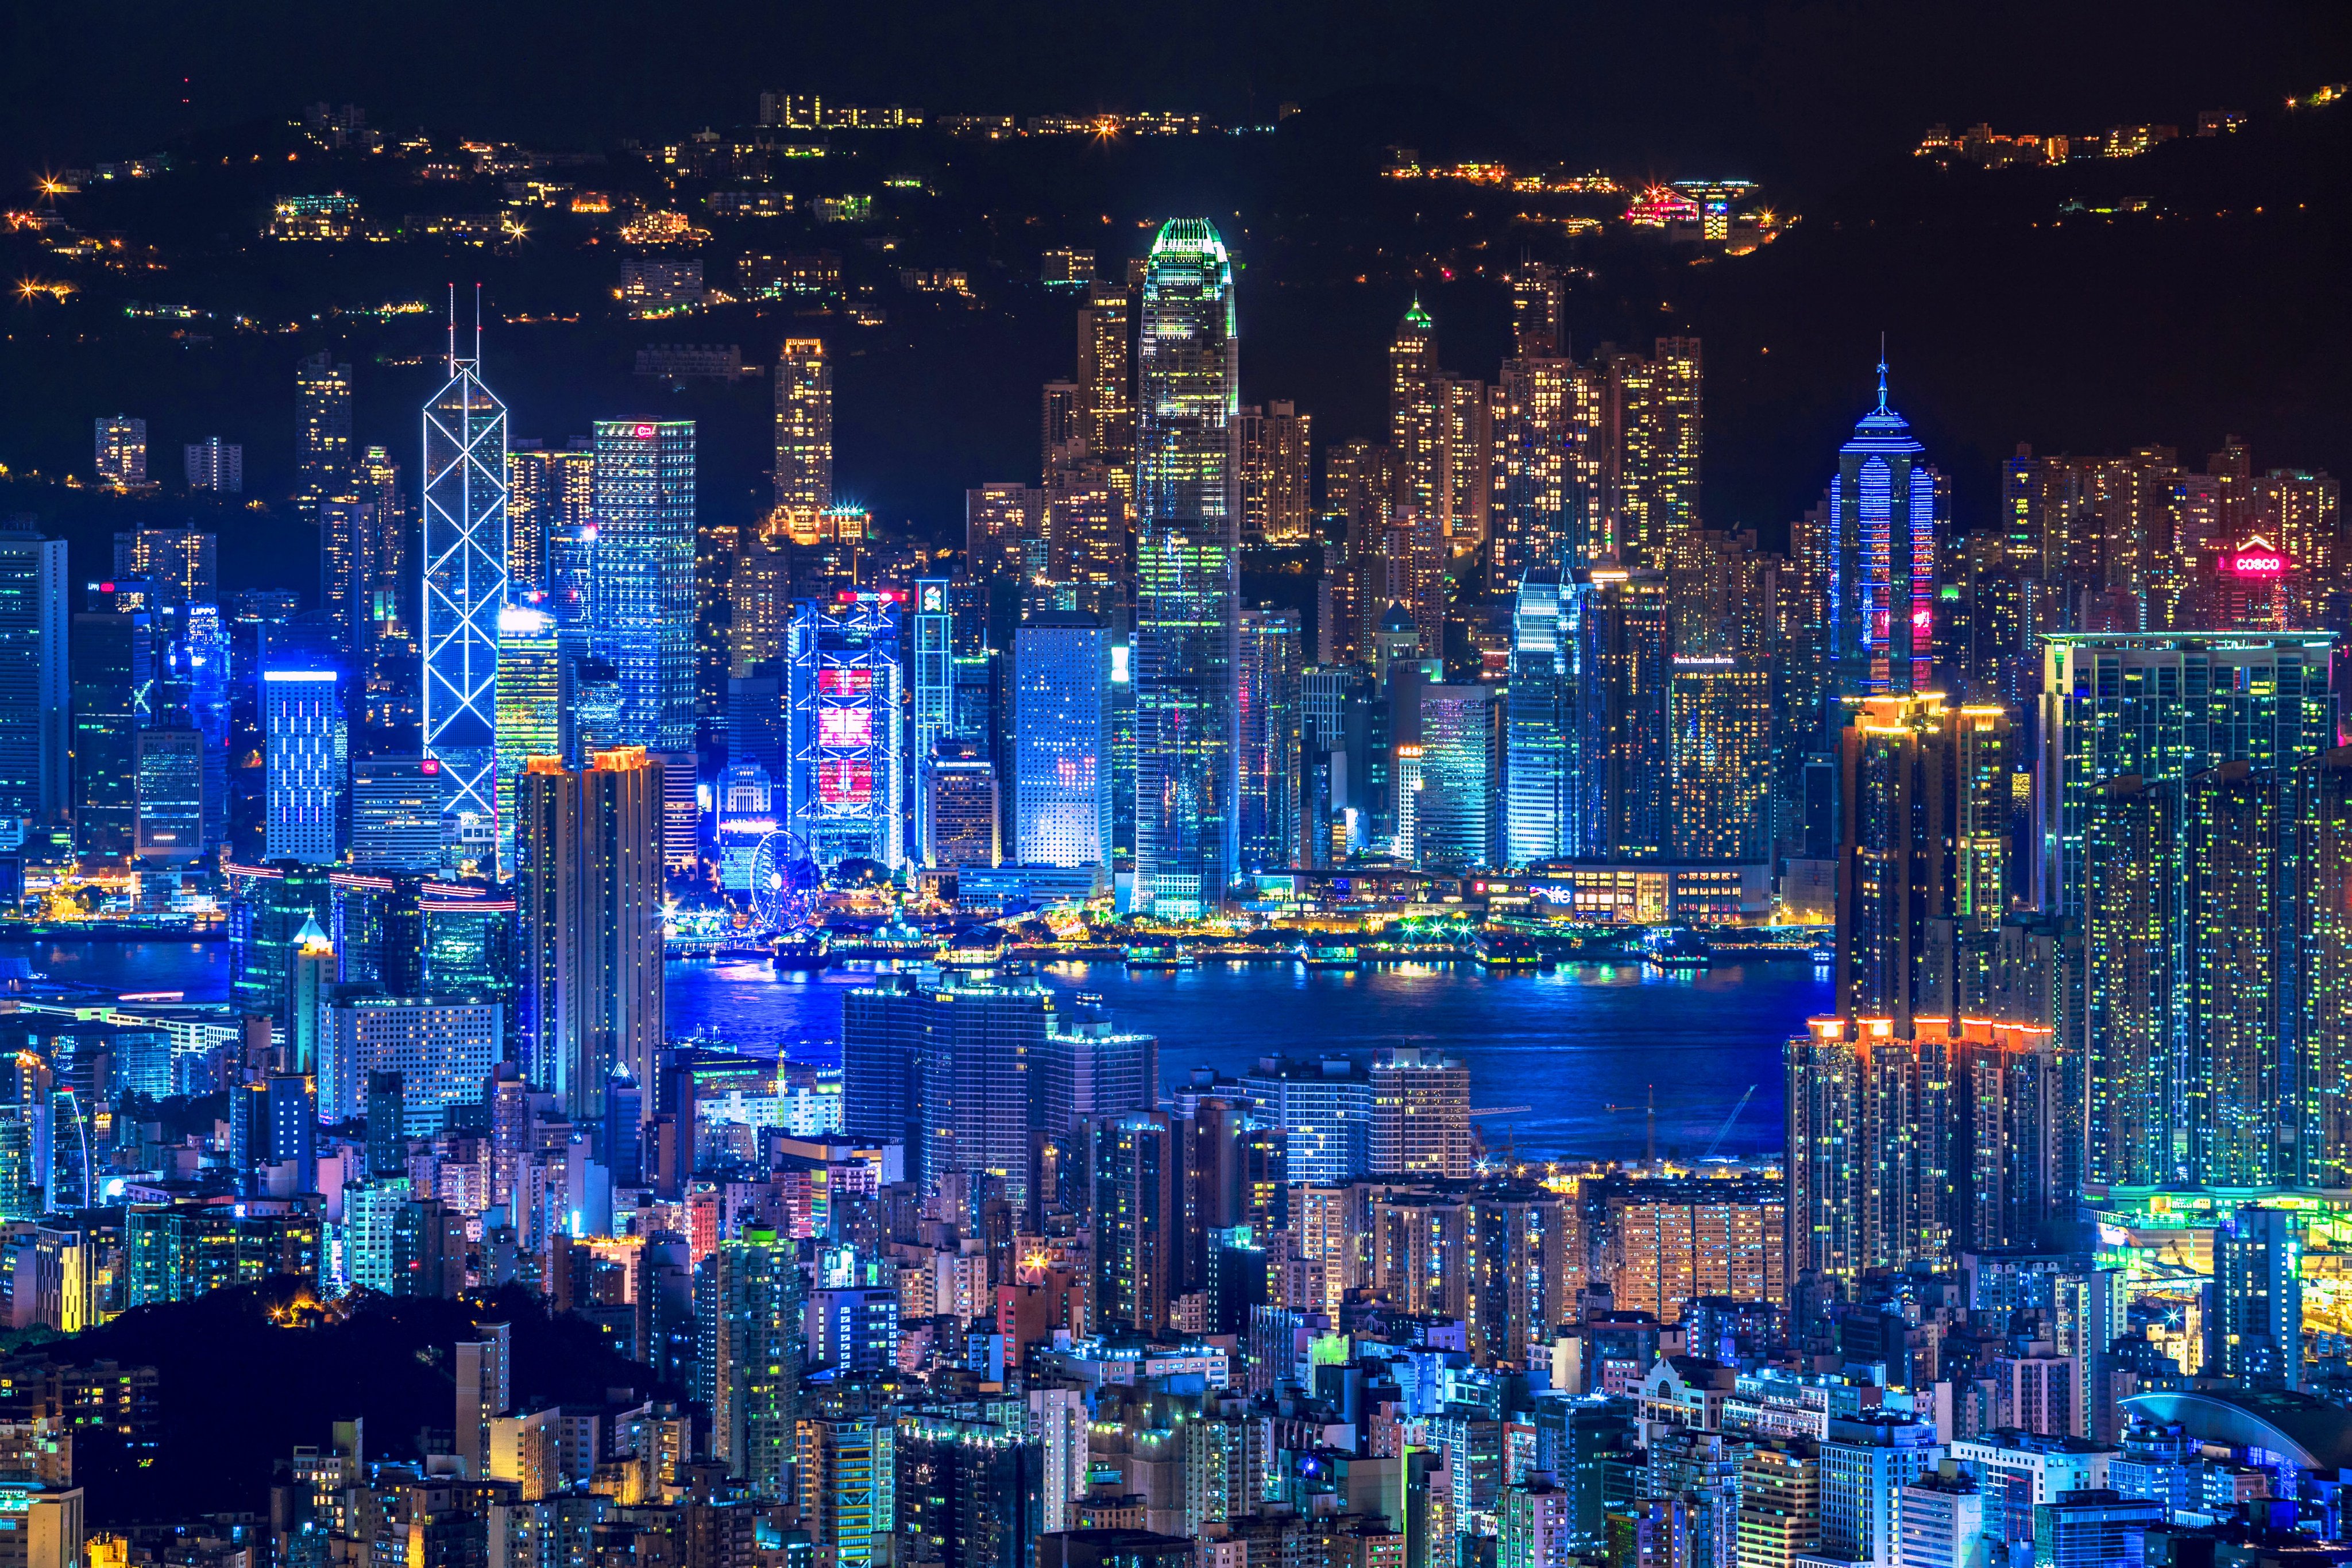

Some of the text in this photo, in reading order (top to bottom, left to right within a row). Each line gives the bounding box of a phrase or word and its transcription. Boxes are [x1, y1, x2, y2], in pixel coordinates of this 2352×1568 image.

[2237, 558, 2280, 570] COSCO
[856, 593, 880, 601] HSBC
[191, 607, 216, 615] LIPPO
